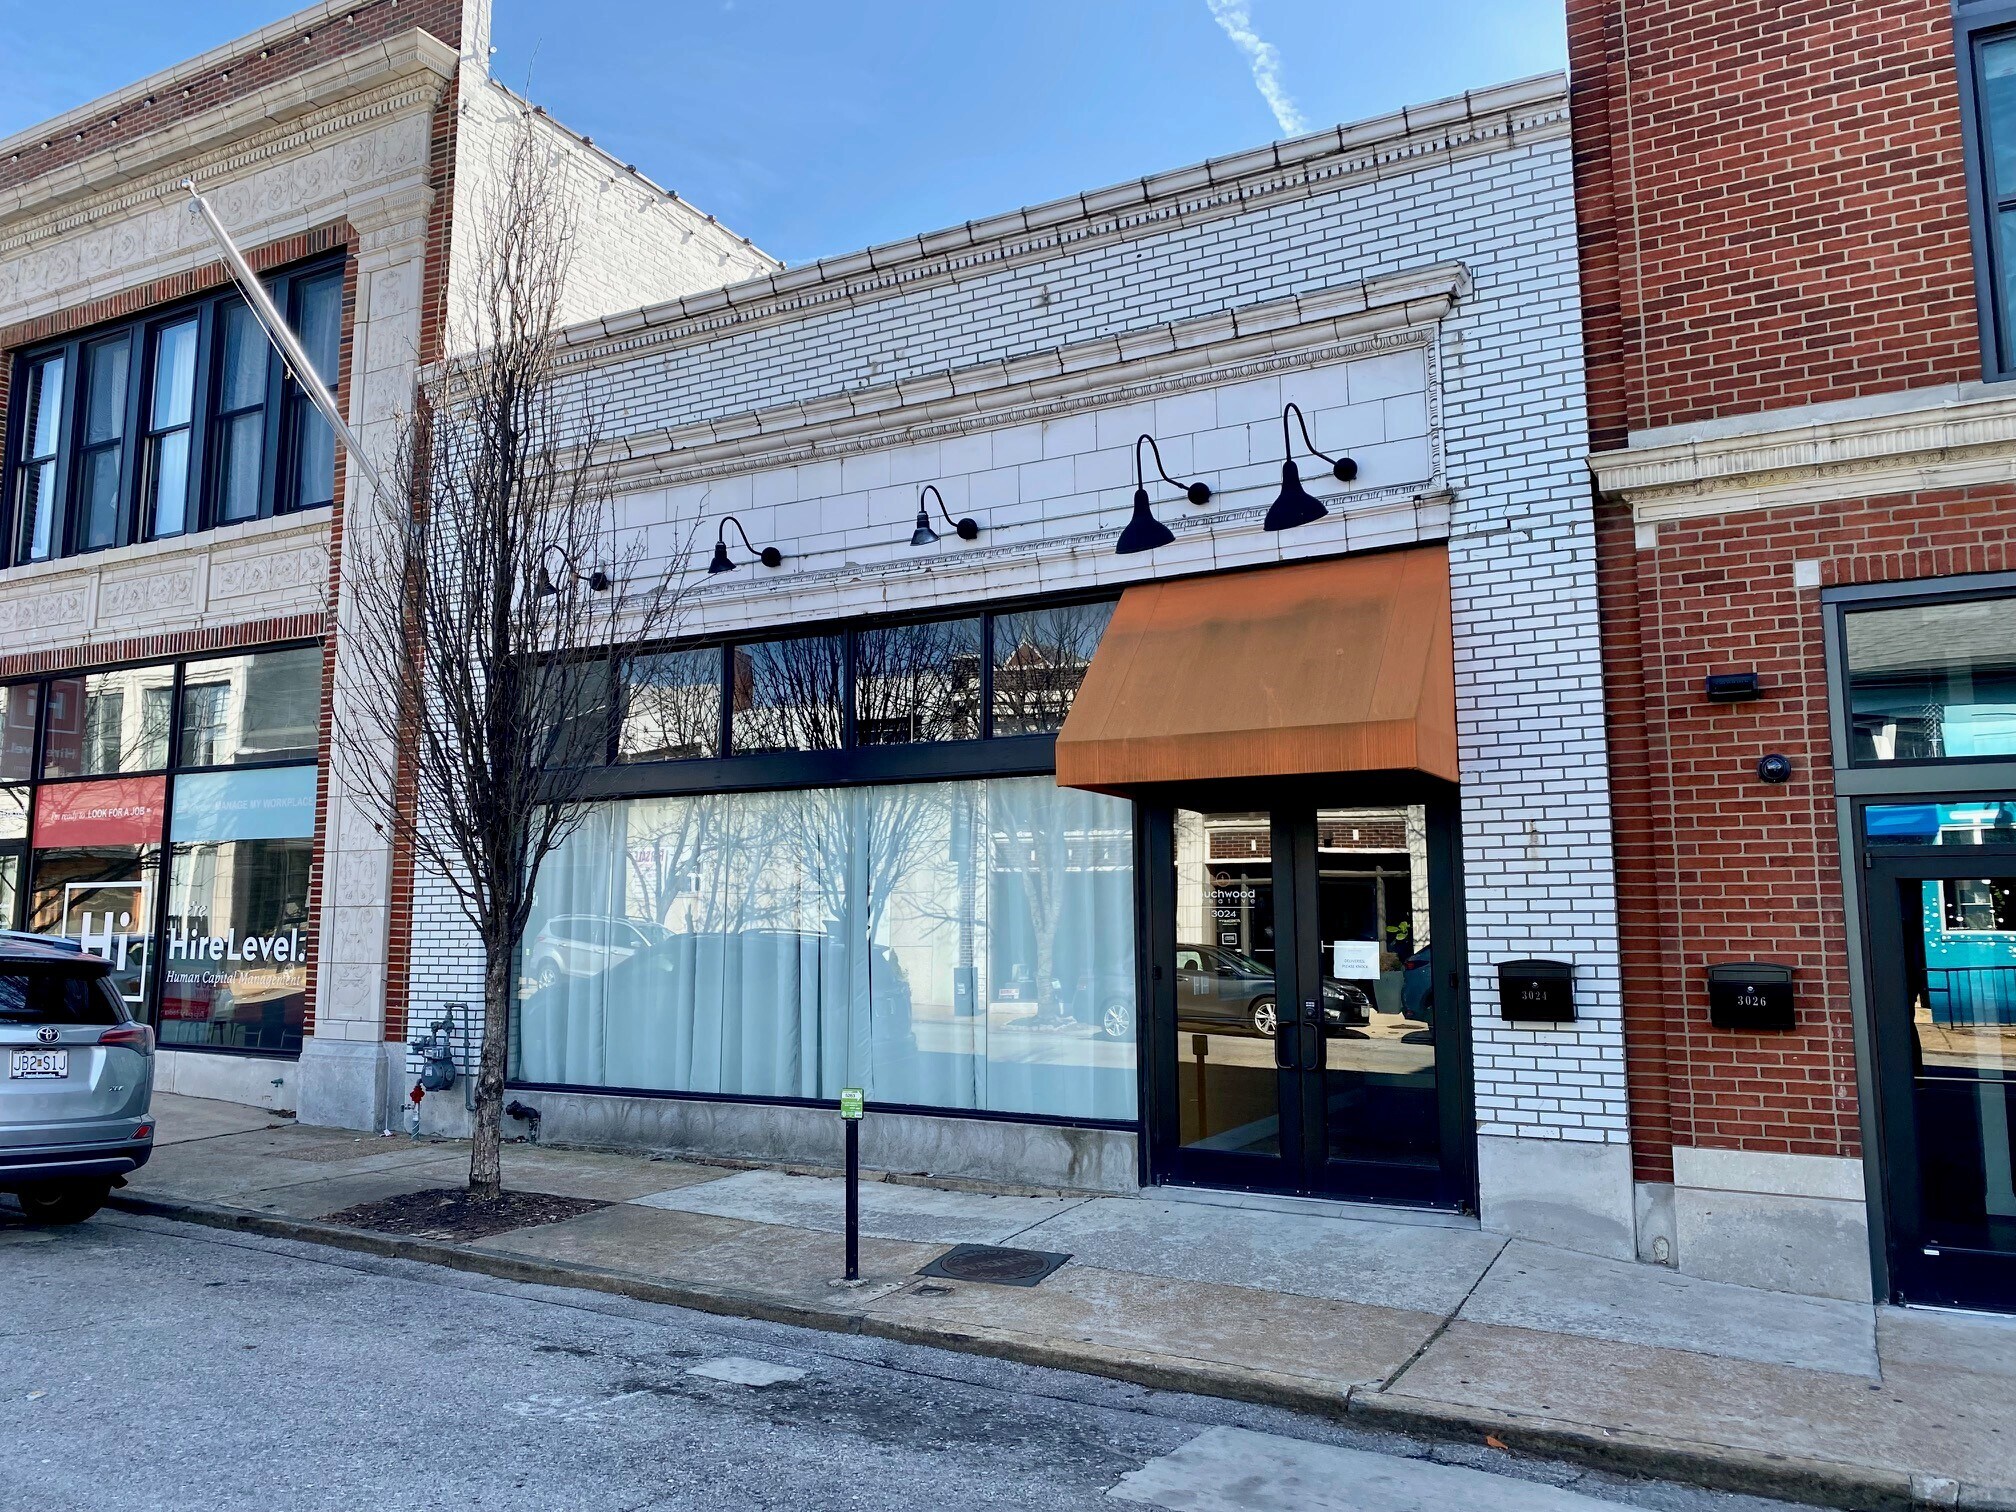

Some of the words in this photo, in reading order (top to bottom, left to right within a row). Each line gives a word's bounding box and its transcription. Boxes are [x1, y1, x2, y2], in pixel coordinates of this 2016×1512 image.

[215, 800, 248, 810] MANAGE
[250, 799, 262, 809] MY
[263, 797, 314, 808] WORKPLACE
[87, 808, 107, 819] LOOK
[109, 807, 123, 817] FOR
[123, 807, 129, 816] A
[130, 806, 145, 816] JOB
[1203, 889, 1256, 898] uchwood
[1211, 909, 1237, 918] 3024
[81, 911, 131, 971] Hi
[166, 970, 200, 983] Human
[202, 970, 237, 987] Capital
[238, 971, 301, 987] Management
[1521, 990, 1548, 1001] 3024
[1737, 995, 1767, 1007] 3026
[14, 1055, 37, 1071] JB2
[43, 1055, 66, 1071] S1J
